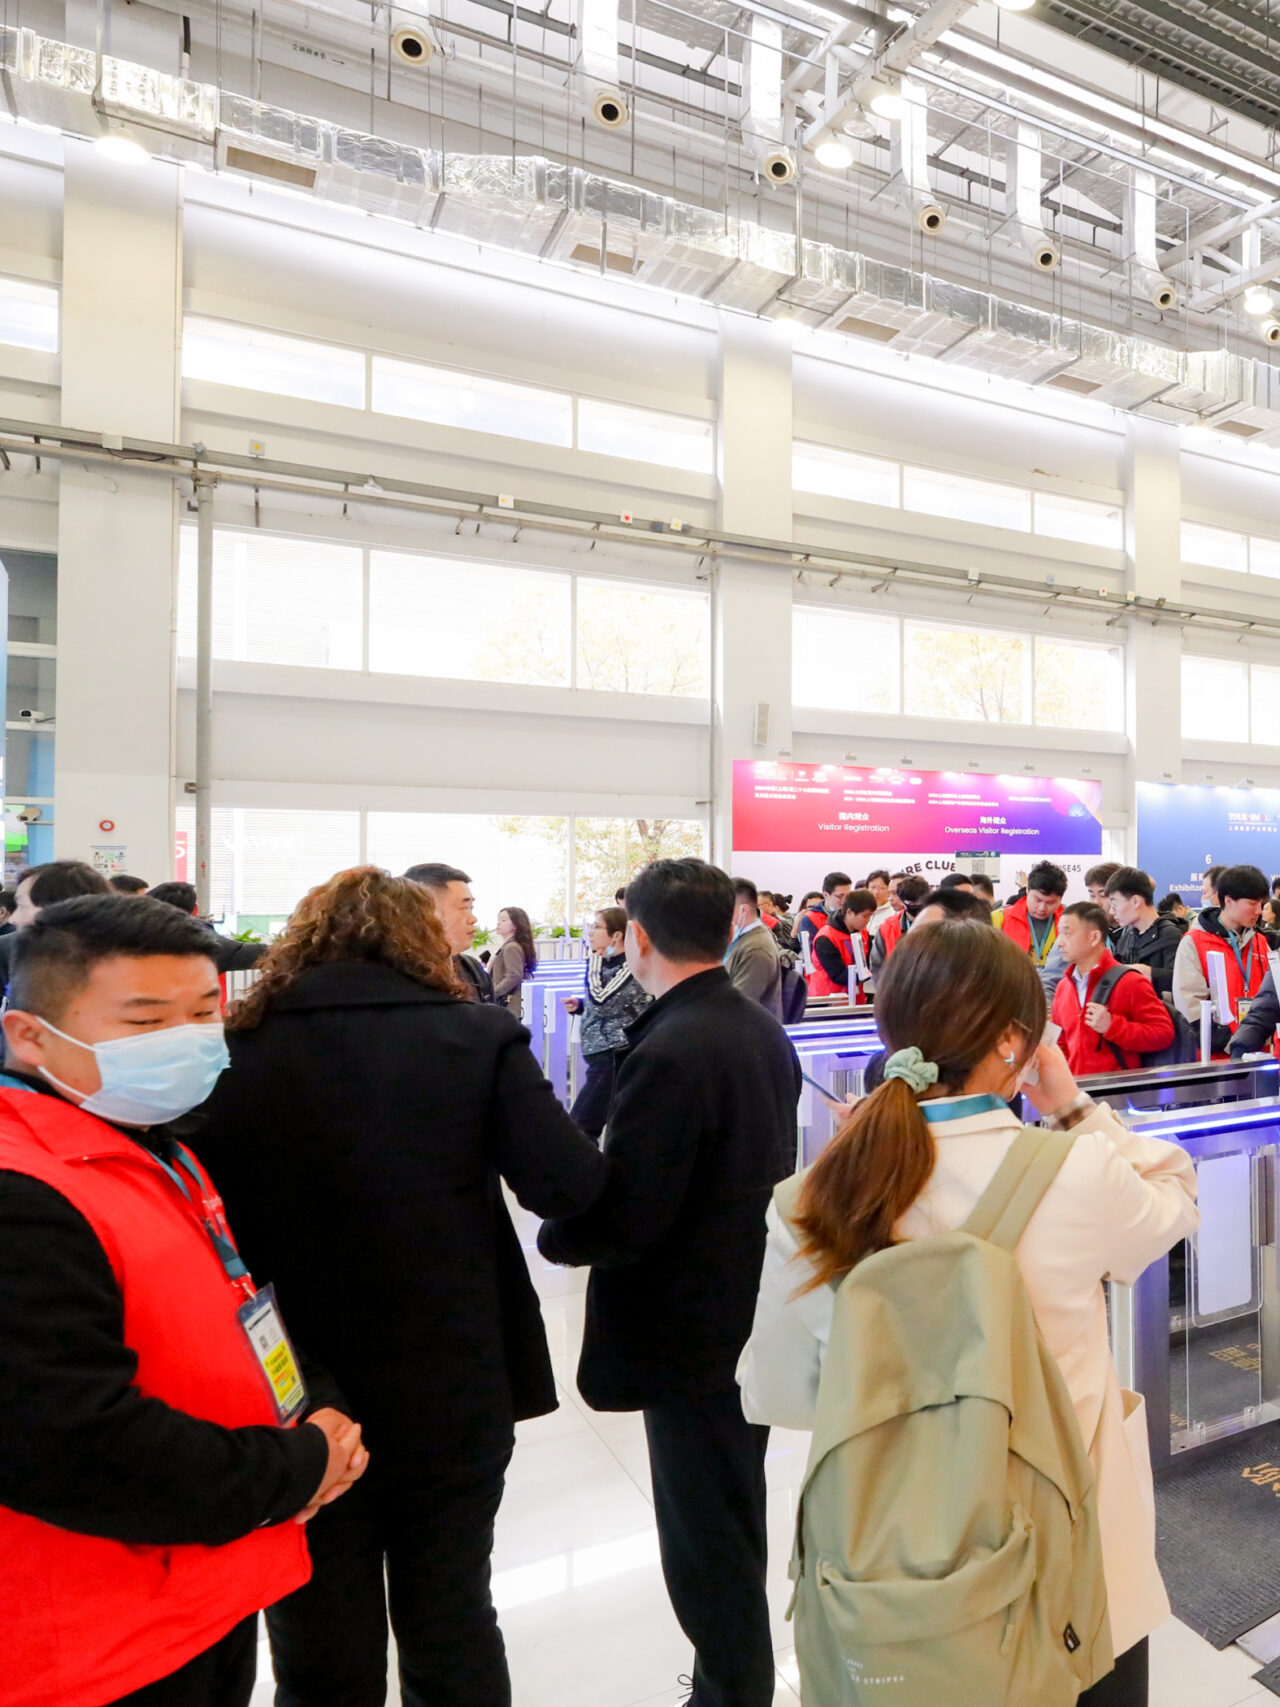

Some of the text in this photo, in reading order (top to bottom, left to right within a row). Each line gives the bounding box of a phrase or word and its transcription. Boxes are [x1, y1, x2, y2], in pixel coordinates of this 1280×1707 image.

[818, 823, 889, 833] Visitor Registration
[944, 826, 977, 834] Overseas
[1001, 828, 1040, 836] Registration
[1204, 854, 1213, 864] 6
